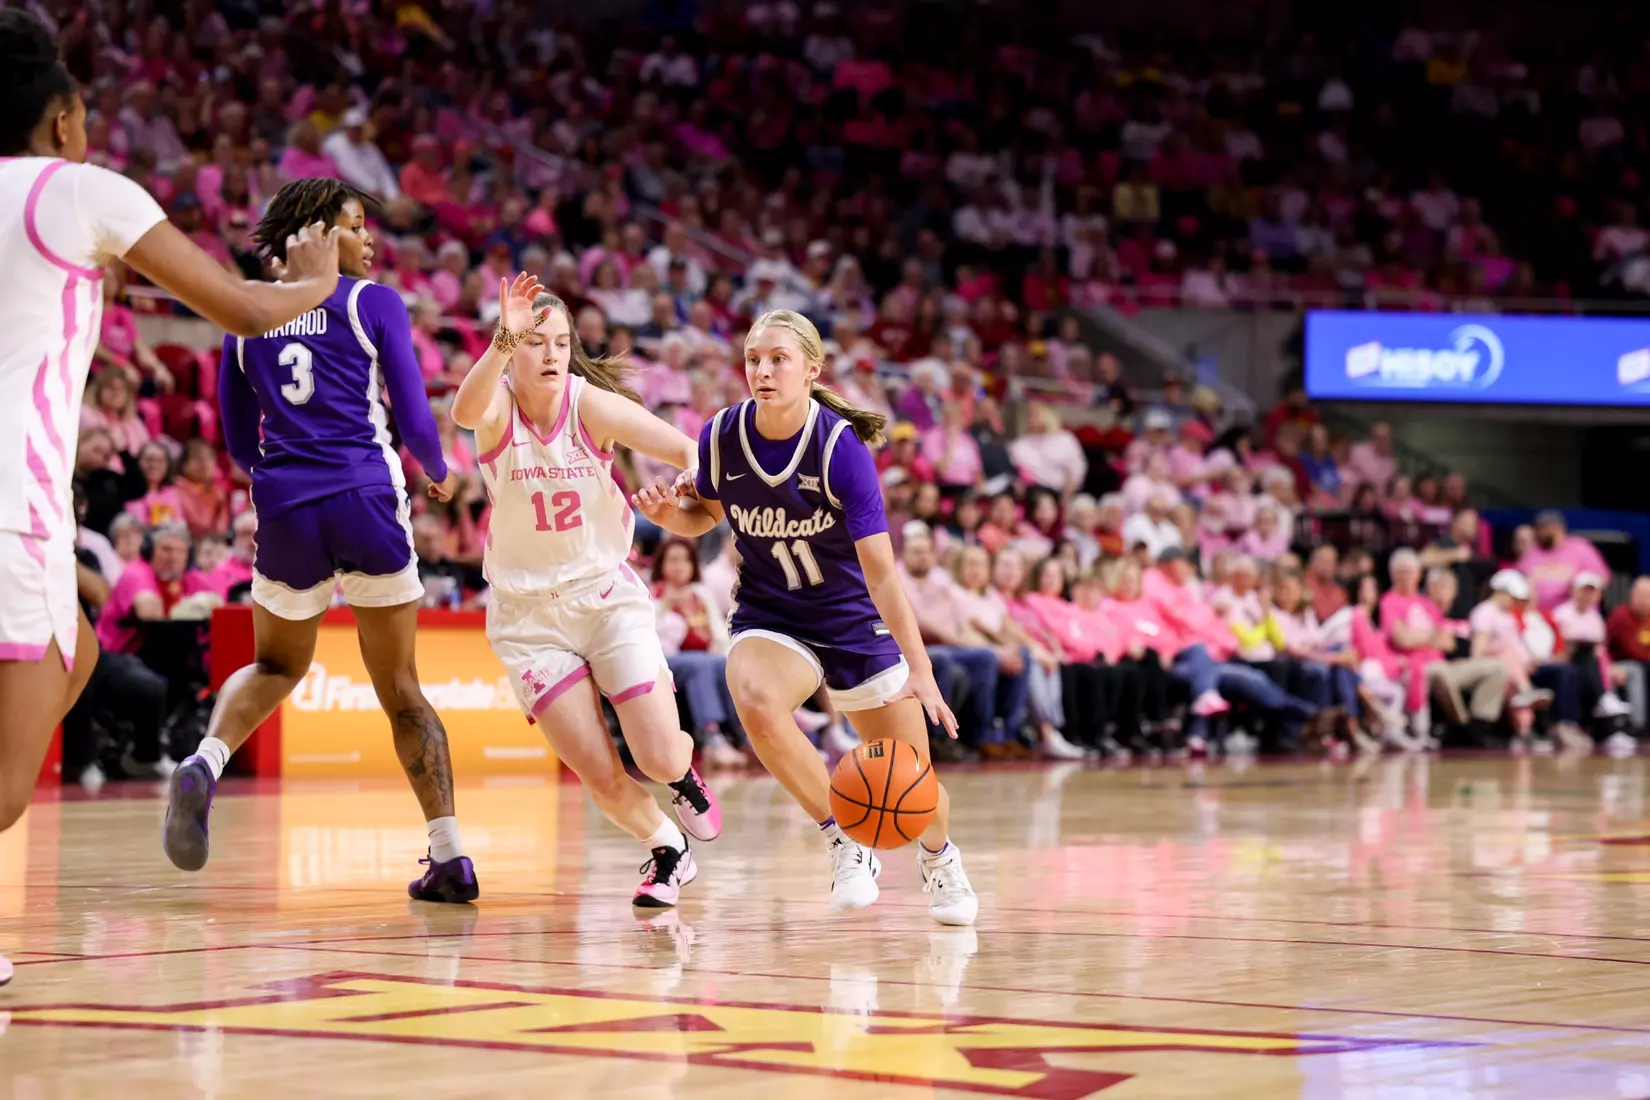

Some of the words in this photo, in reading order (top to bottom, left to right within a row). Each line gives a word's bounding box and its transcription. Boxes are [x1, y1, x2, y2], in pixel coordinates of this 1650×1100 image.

[278, 342, 315, 405] 3
[511, 466, 547, 481] IOWA
[548, 466, 595, 480] STATE
[531, 490, 583, 532] 12
[730, 504, 837, 538] Wildcats
[771, 540, 825, 590] 11
